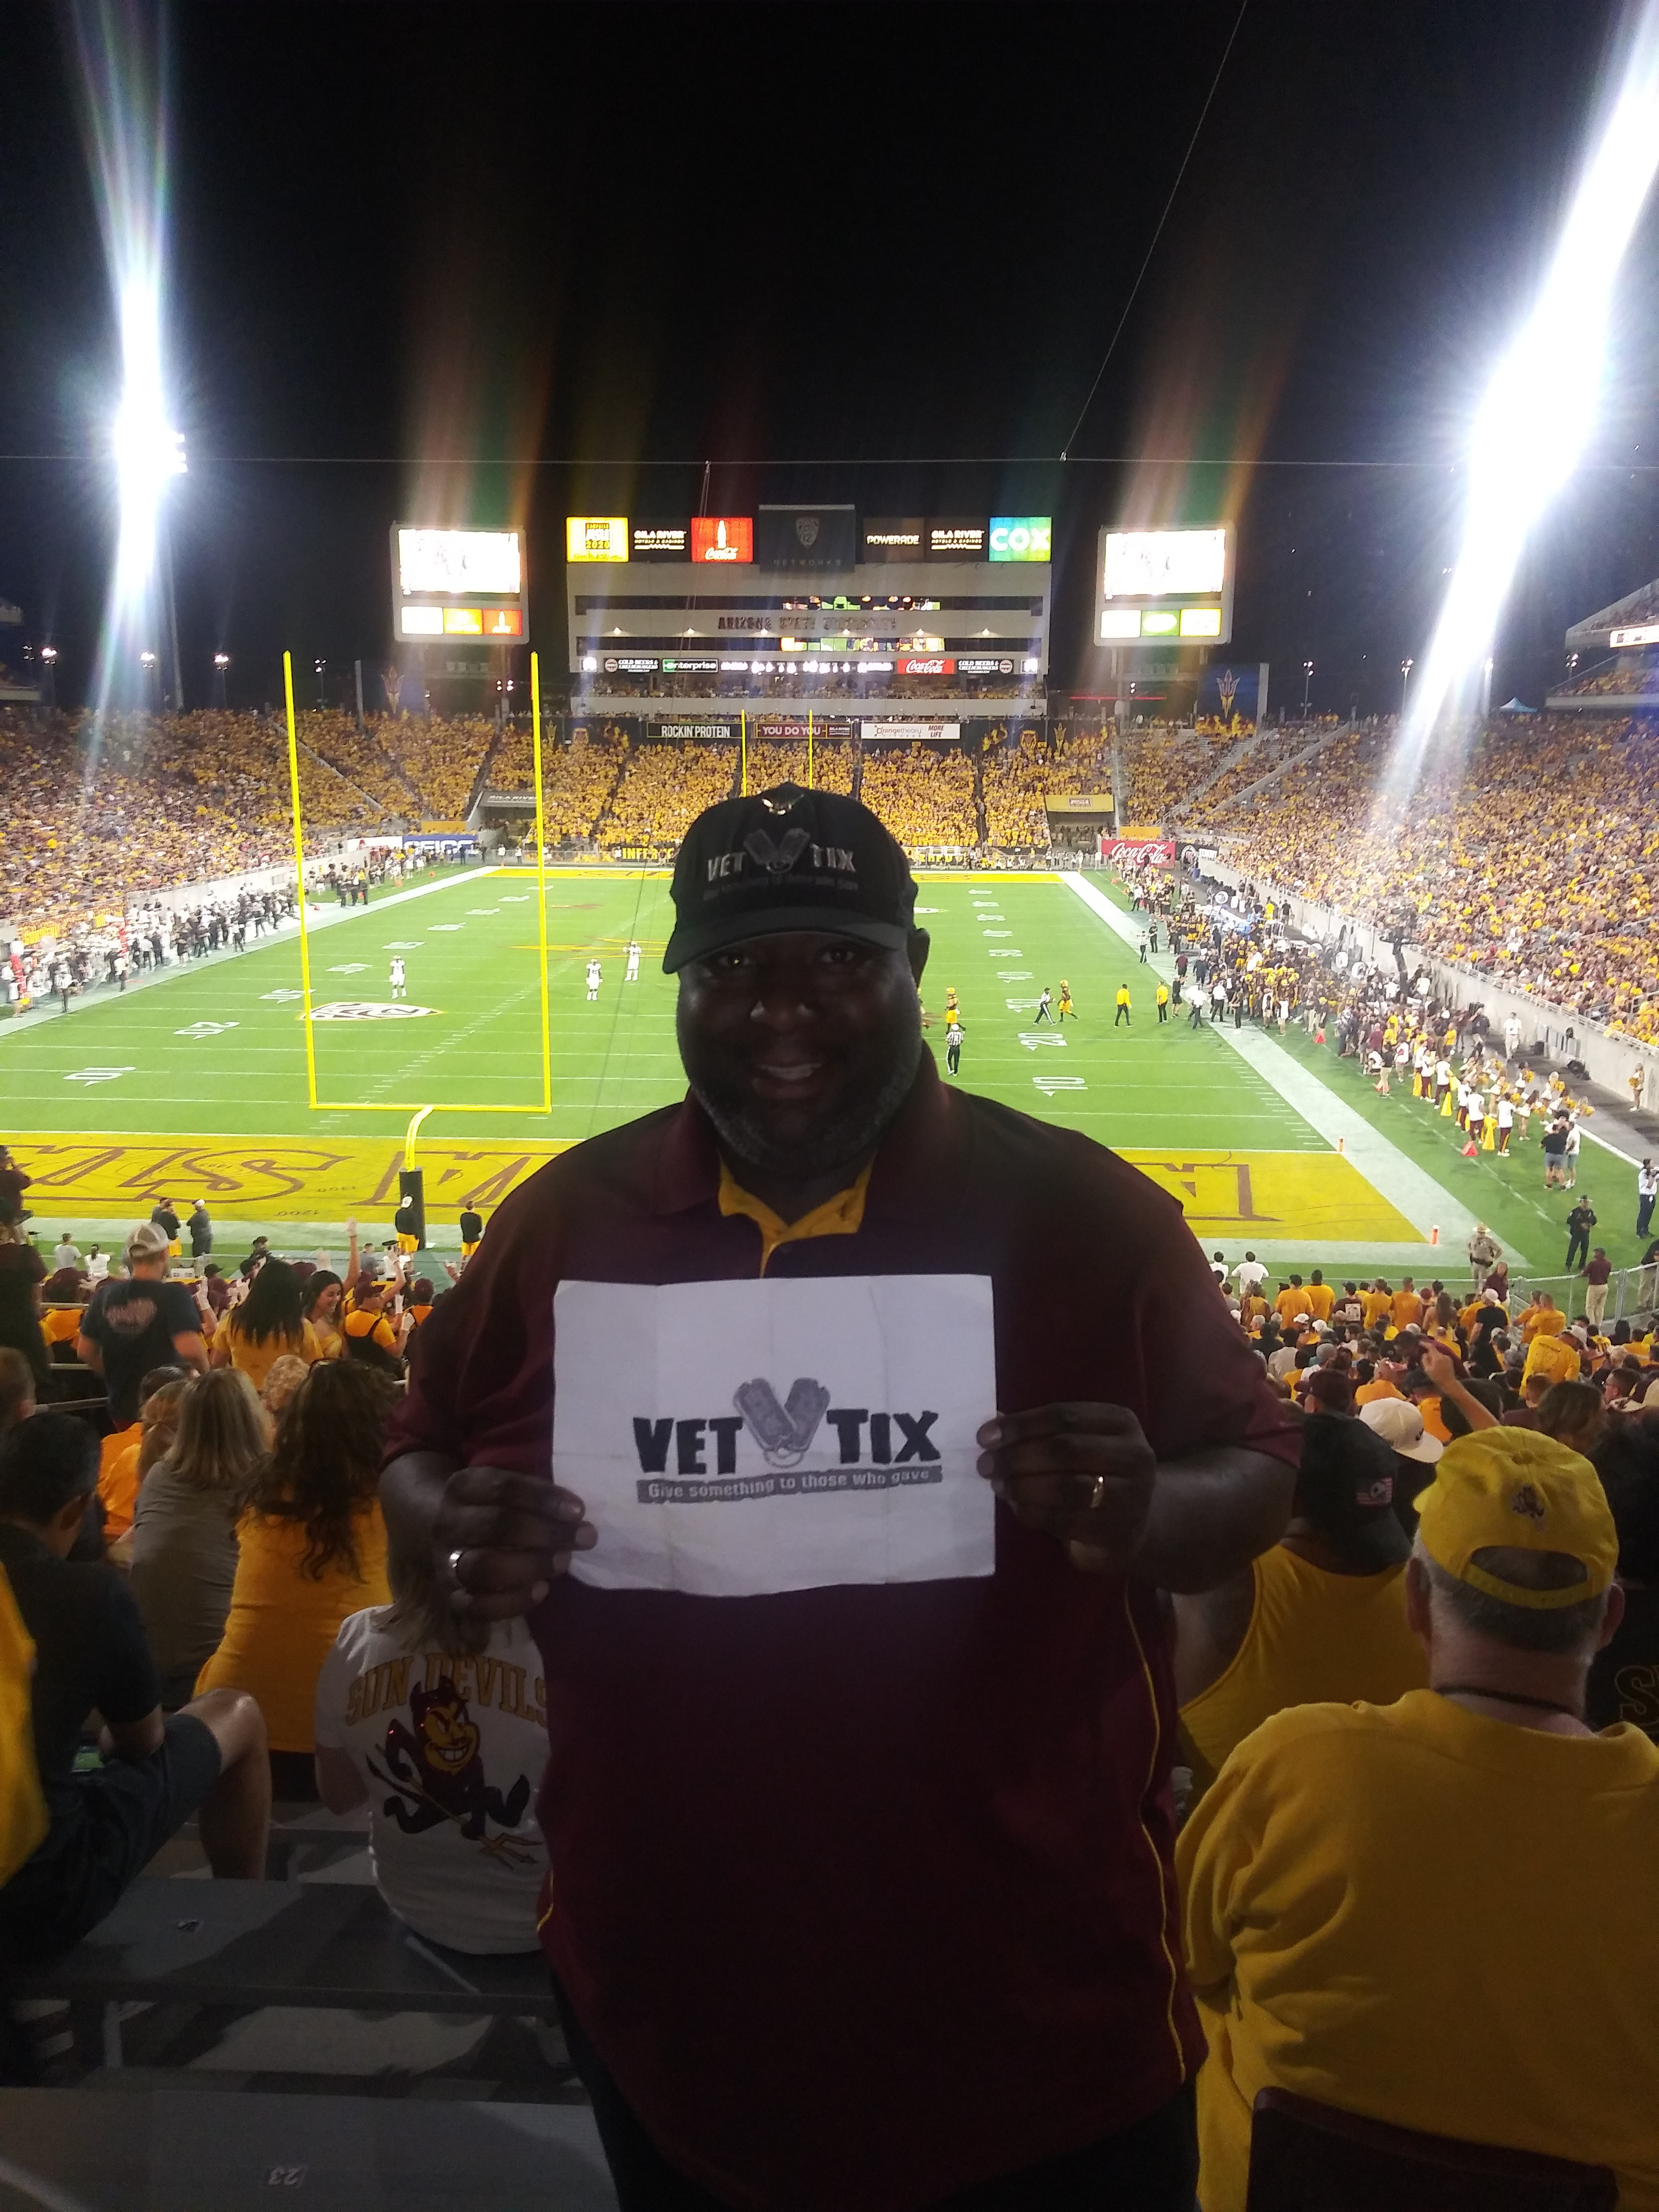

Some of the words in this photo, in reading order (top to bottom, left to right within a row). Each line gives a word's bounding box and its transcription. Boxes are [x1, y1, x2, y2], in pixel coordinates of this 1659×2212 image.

[656, 530, 685, 539] RIVER
[866, 534, 920, 545] POWERADE
[954, 530, 983, 539] RIVER
[990, 527, 1050, 551] COX
[585, 540, 610, 549] 2020
[665, 661, 716, 670] enterprise
[906, 659, 945, 673] Coca-Cola
[695, 726, 730, 738] PROTEIN
[763, 726, 783, 735] YOU
[785, 726, 799, 735] DO
[404, 840, 475, 854] GEICO
[1111, 843, 1168, 864] Coca-Cola
[707, 852, 745, 882] VET
[810, 843, 856, 873] TIX
[633, 1417, 743, 1474] VET
[827, 1409, 942, 1464] TIX
[648, 1483, 684, 1498] Give
[690, 1477, 774, 1498] something
[779, 1475, 795, 1489] to
[802, 1473, 847, 1488] those
[853, 1471, 886, 1486] who
[892, 1469, 929, 1485] gave
[345, 1655, 414, 1727] SUN
